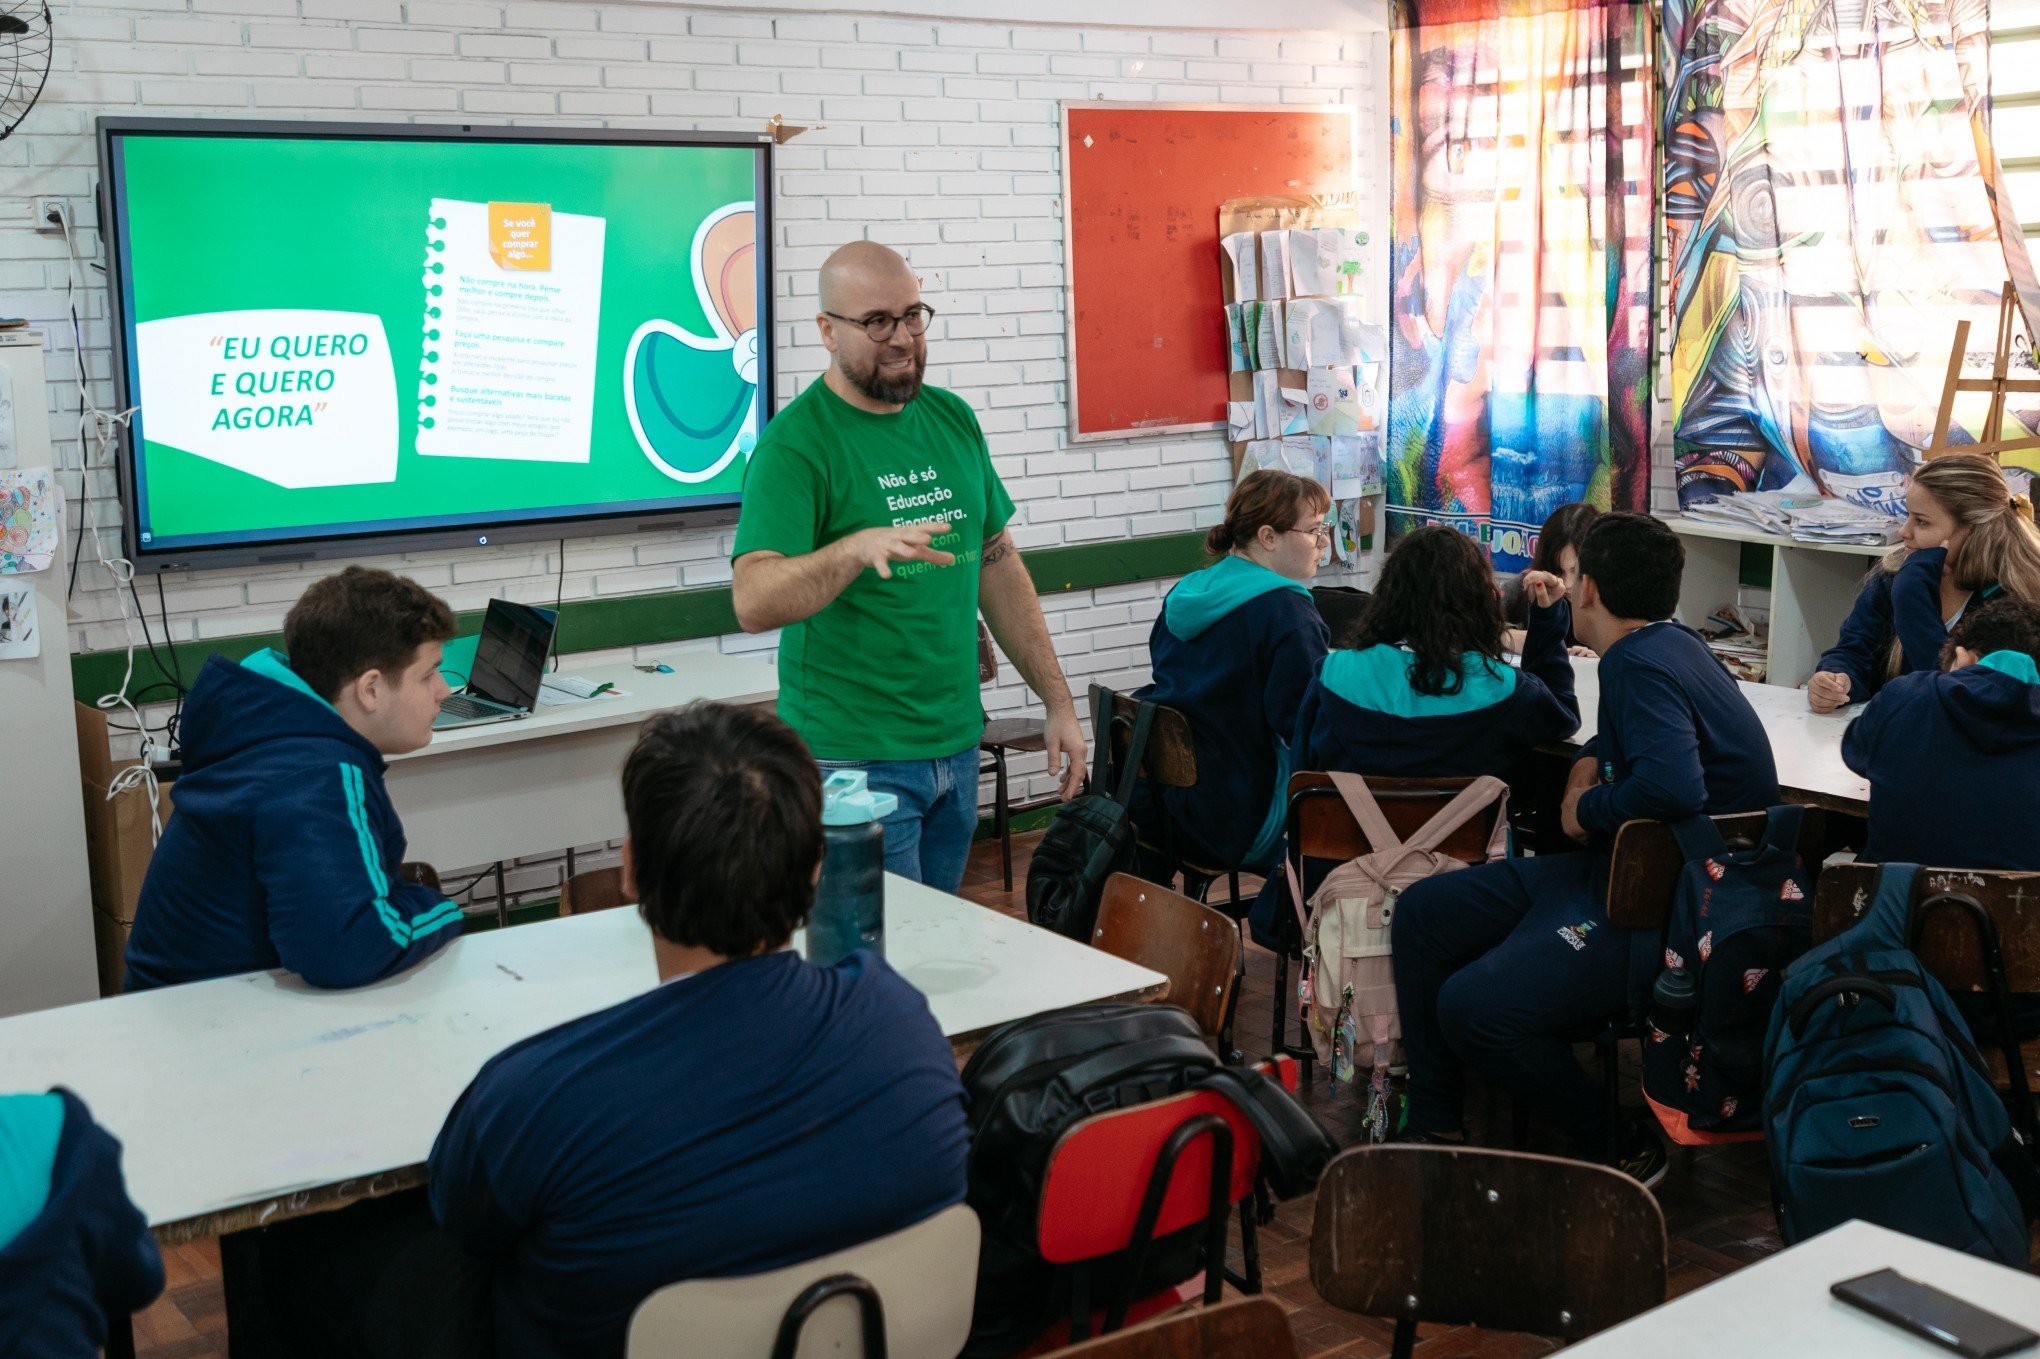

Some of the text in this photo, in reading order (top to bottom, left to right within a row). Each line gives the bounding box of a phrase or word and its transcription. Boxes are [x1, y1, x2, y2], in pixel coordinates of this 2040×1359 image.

[504, 218, 536, 228] Se você
[510, 231, 530, 240] quer
[503, 241, 538, 250] comprar
[459, 286, 486, 294] melhor
[494, 290, 522, 300] compre
[460, 276, 475, 284] Não
[477, 279, 505, 288] compre
[540, 284, 561, 294] Pense
[270, 333, 368, 361] QUERO
[456, 330, 471, 338] Faça
[474, 332, 490, 340] uma
[492, 335, 526, 344] pesquisa
[533, 340, 565, 348] compare
[210, 368, 335, 397] E QUERO
[450, 386, 478, 395] Busque
[480, 388, 523, 398] alternativas
[544, 393, 571, 401] baratas
[878, 466, 938, 490] Não é só
[886, 486, 953, 511] Educação
